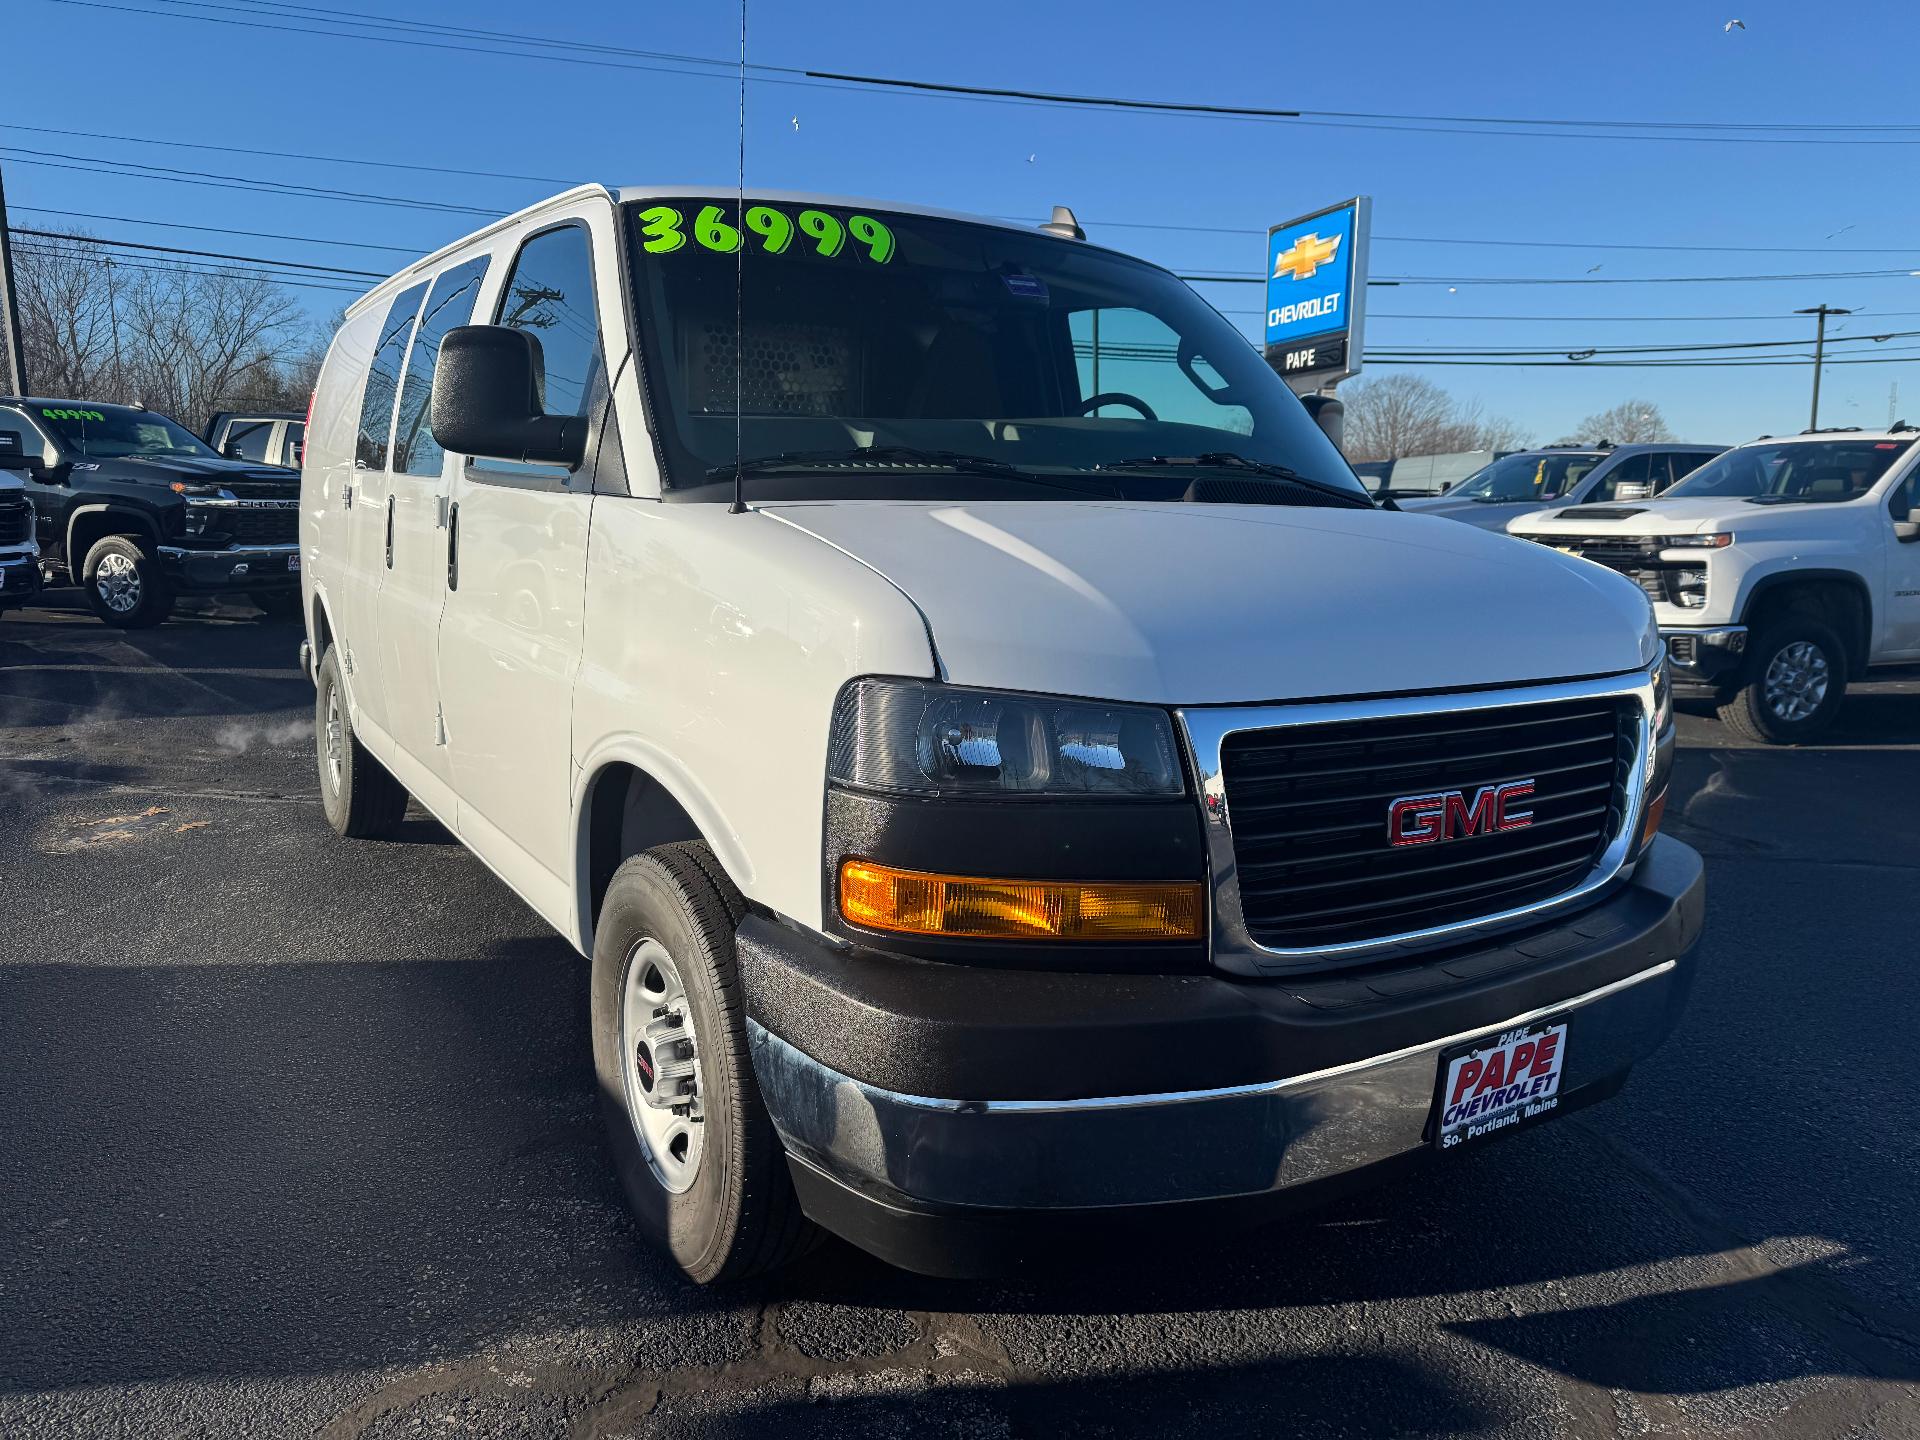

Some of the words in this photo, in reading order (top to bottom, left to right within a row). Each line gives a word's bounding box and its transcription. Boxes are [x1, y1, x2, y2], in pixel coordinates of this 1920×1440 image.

[639, 205, 895, 264] 36999
[1268, 292, 1341, 327] CHEVROLET
[1286, 348, 1316, 370] PAPE
[42, 408, 105, 421] 49999
[1387, 778, 1535, 847] GMC
[1498, 1026, 1531, 1047] PAPE
[1450, 1032, 1559, 1106] PAPE
[1442, 1072, 1557, 1126] CHEVROLET
[1443, 1134, 1463, 1148] So.
[1467, 1110, 1520, 1139] Portland,
[1524, 1098, 1558, 1118] Maine
